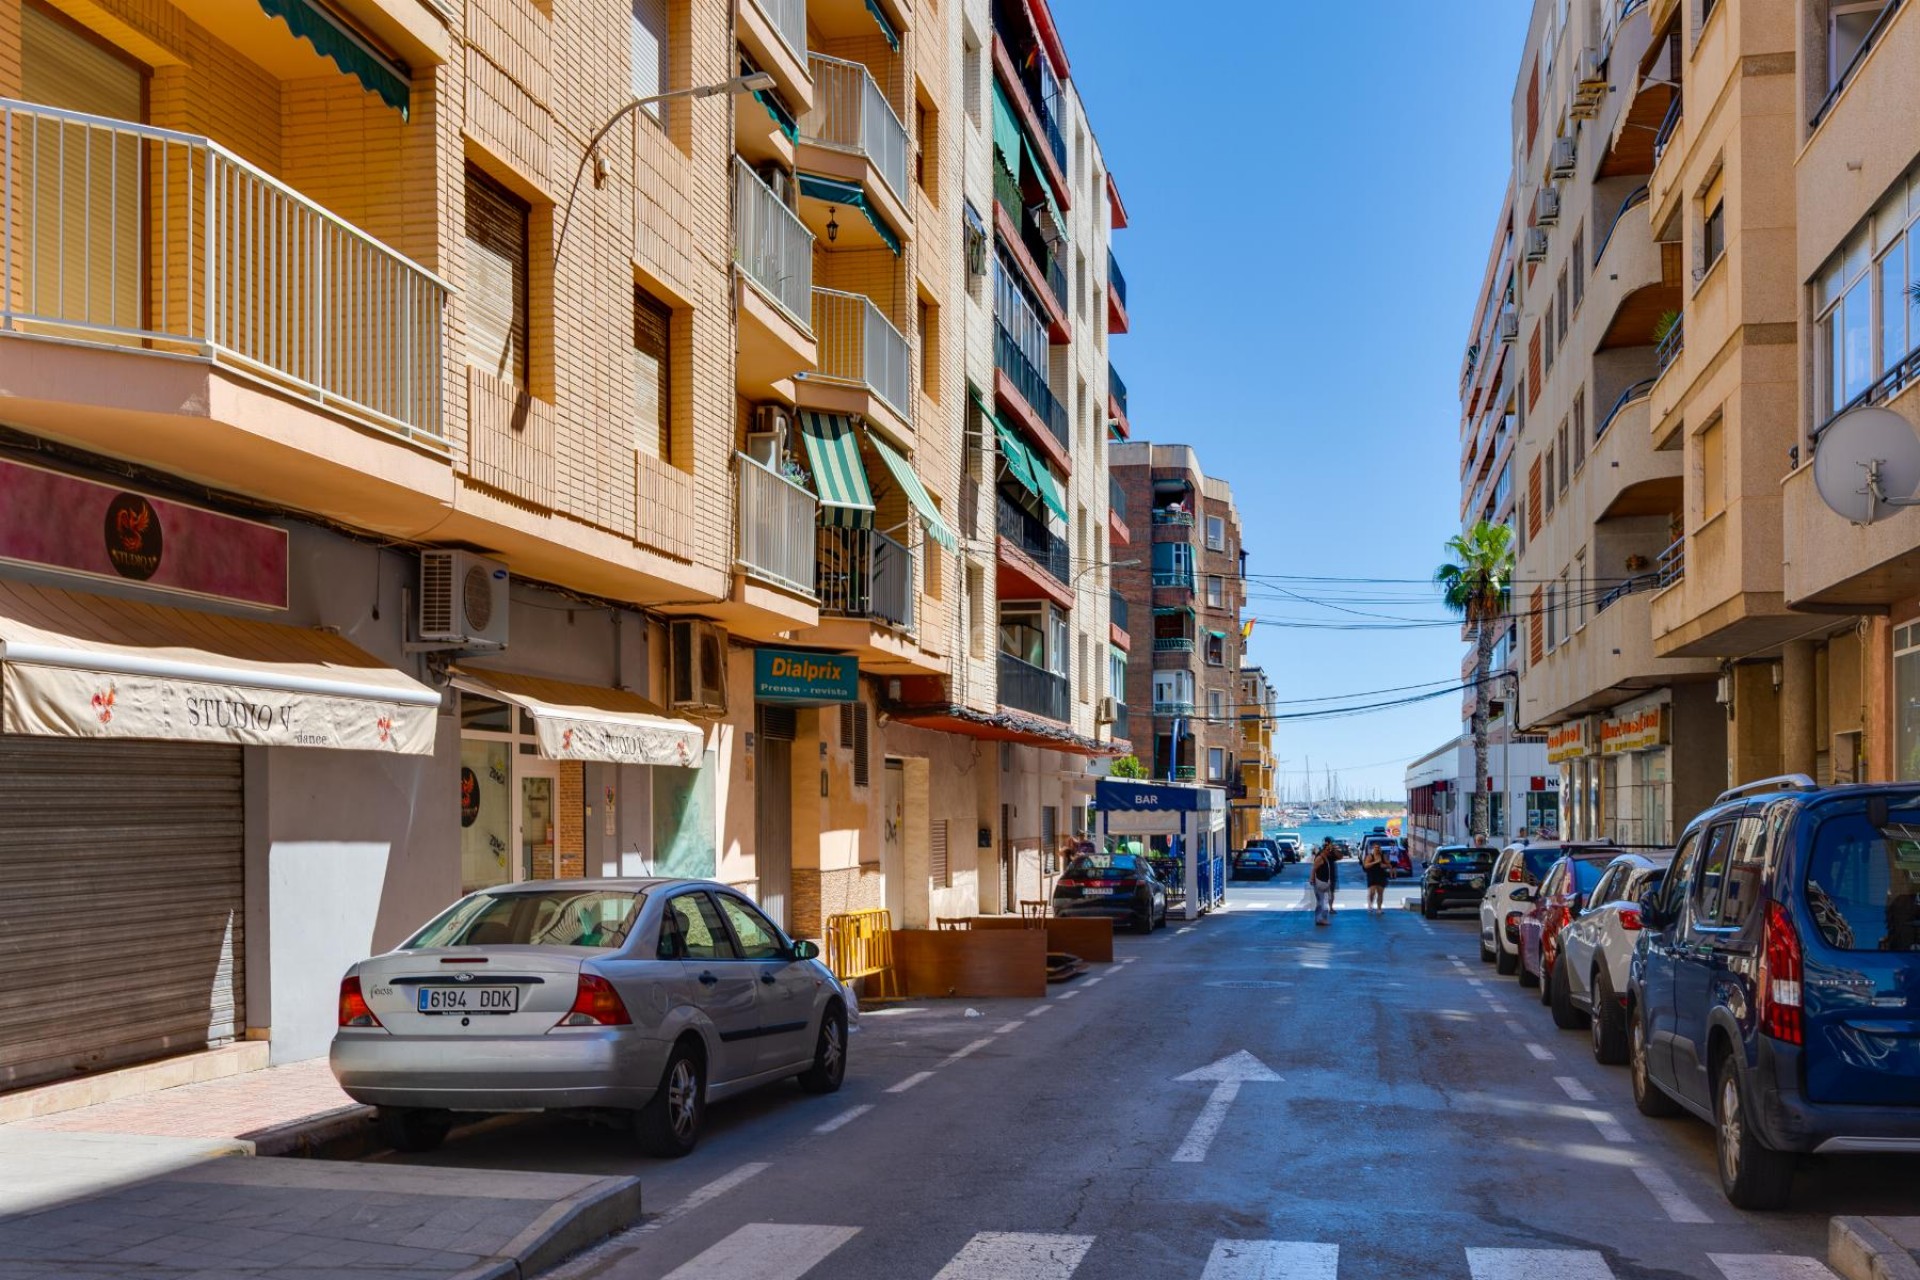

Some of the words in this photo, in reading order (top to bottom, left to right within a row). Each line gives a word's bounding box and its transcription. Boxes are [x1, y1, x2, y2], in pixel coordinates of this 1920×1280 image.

[772, 657, 841, 682] Dialprix
[761, 683, 800, 693] Prensa
[810, 686, 848, 695] revista
[186, 697, 273, 731] STUDIO
[279, 705, 293, 731] V
[296, 730, 328, 745] dance
[1135, 795, 1158, 804] BAR
[430, 991, 467, 1008] 6194
[480, 990, 512, 1008] DDK
